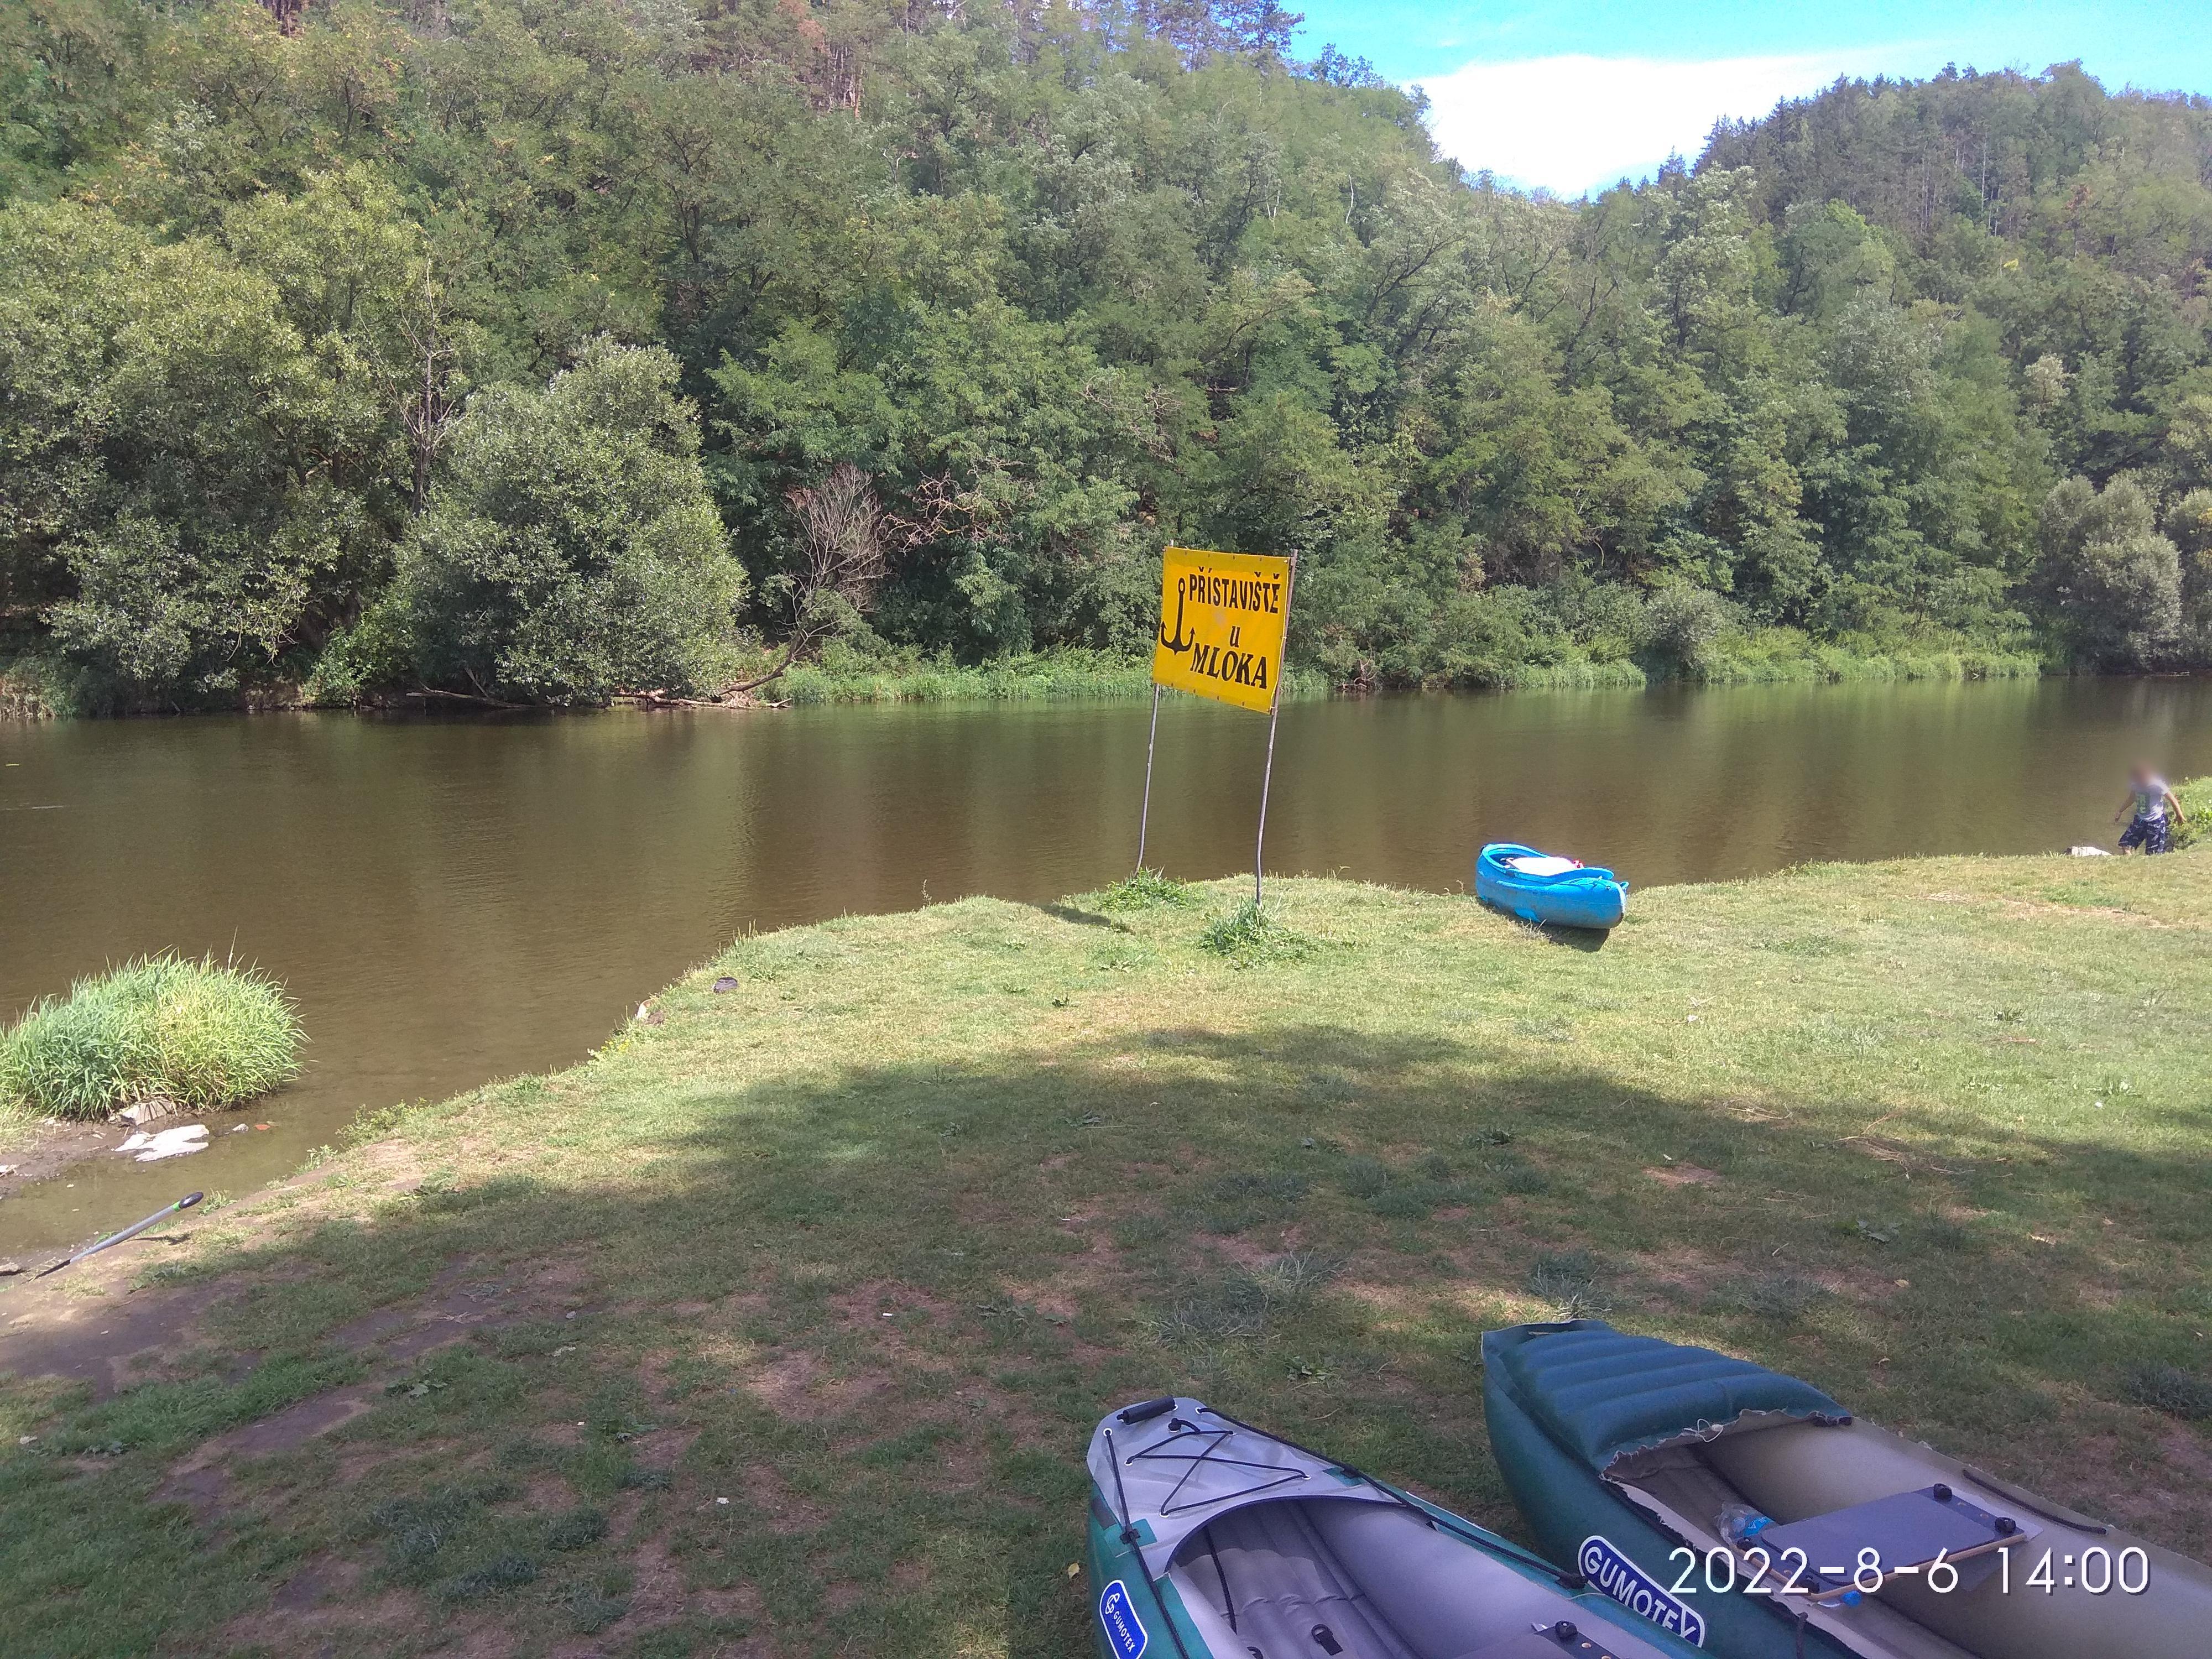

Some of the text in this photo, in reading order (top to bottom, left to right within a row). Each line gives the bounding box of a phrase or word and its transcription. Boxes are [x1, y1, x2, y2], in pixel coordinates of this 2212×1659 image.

[1189, 566, 1281, 614] PŘÍSTAVIŠTĚ
[1190, 643, 1267, 690] MLOKA
[1113, 1611, 1135, 1653] GUMOTEX
